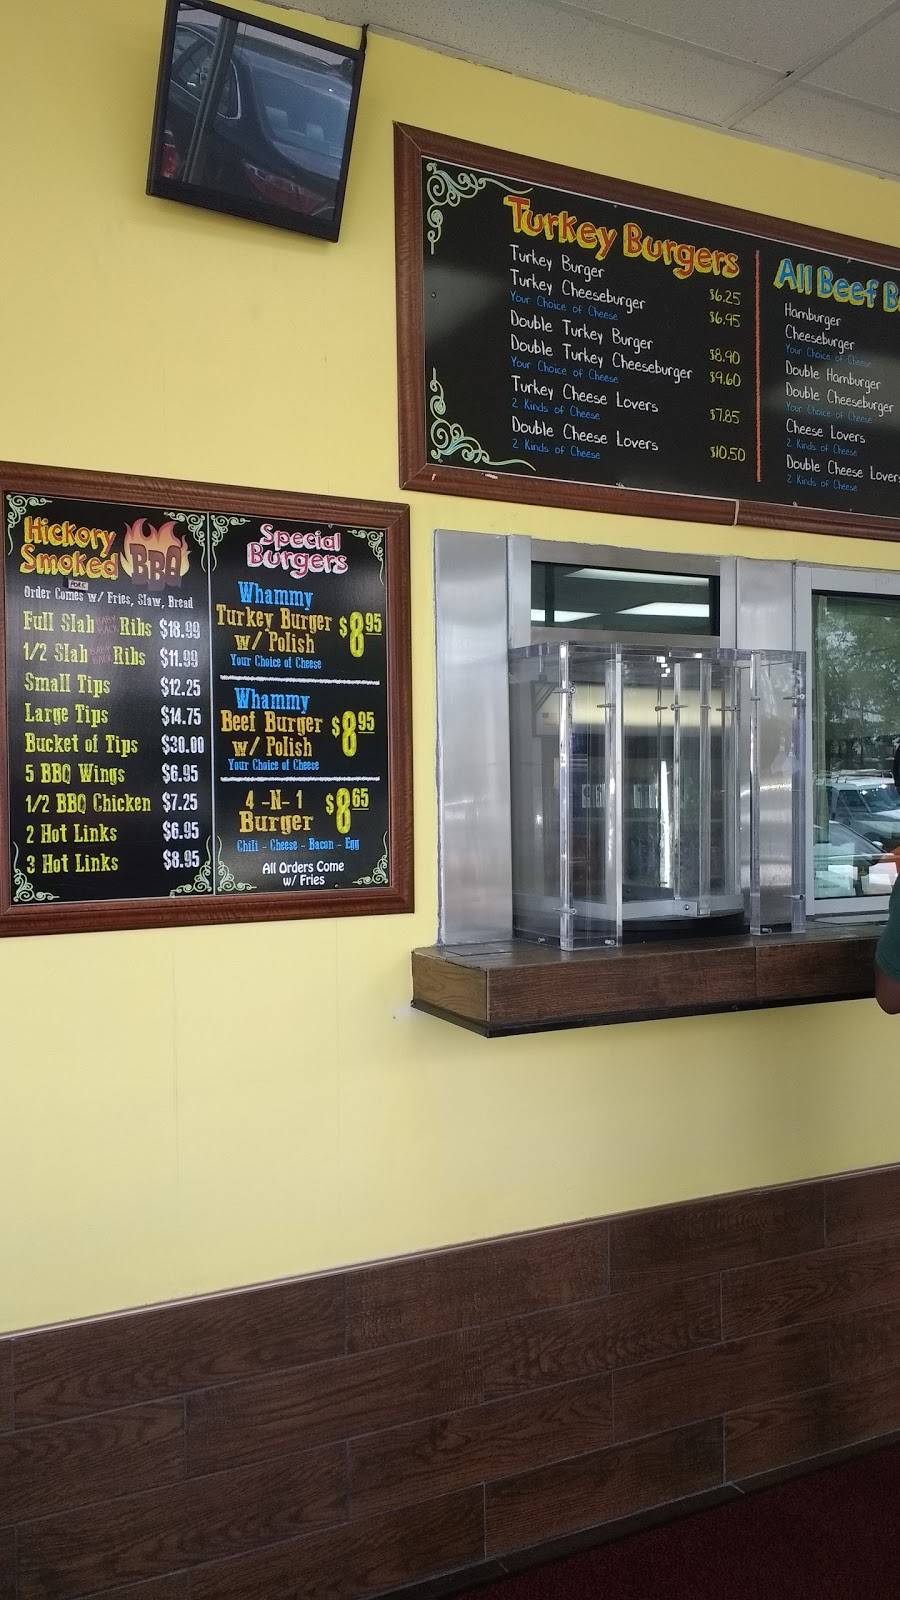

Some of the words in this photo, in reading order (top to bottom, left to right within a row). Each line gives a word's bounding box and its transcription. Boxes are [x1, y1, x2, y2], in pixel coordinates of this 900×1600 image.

[503, 195, 617, 261] Turkey
[623, 222, 740, 280] Burgers
[510, 244, 552, 270] Turkey
[561, 254, 605, 283] Burger
[510, 269, 553, 295] Turkey
[561, 280, 646, 314] Cheeseburger
[709, 289, 741, 305] $6.25
[773, 258, 813, 295] All
[817, 265, 879, 308] Beef
[883, 281, 900, 313] B
[510, 291, 530, 305] Your
[536, 296, 566, 311] Choice
[572, 305, 583, 314] of
[588, 307, 618, 321] Cheese
[785, 303, 841, 331] Hamburger
[709, 311, 741, 327] $6.95
[510, 310, 553, 333] Double
[562, 319, 603, 345] Turkey
[612, 328, 654, 354] Burger
[785, 324, 855, 355] Cheeseburger
[511, 334, 553, 357] Double
[562, 343, 604, 368] Turkey
[612, 352, 693, 384] Cheeseburger
[709, 348, 741, 365] $8.90
[785, 344, 801, 355] Your
[807, 347, 830, 361] Choice
[835, 354, 845, 363] of
[848, 355, 872, 368] Cheese
[511, 356, 530, 369] Your
[538, 361, 567, 376] Choice
[573, 368, 583, 377] of
[589, 370, 619, 384] Cheese
[709, 371, 741, 387] $9.60
[785, 360, 820, 379] Double
[826, 368, 881, 394] Hamburger
[511, 375, 553, 400] Turkey
[563, 383, 607, 405] Cheese
[616, 392, 659, 413] Lovers
[785, 382, 820, 401] Double
[827, 389, 894, 417] Cheeseburger
[512, 399, 518, 408] 2
[524, 401, 548, 413] Kinds
[555, 406, 565, 415] of
[570, 406, 601, 420] Cheese
[709, 408, 741, 424] $7.85
[785, 403, 802, 414] Your
[807, 405, 832, 417] Choice
[836, 411, 846, 419] of
[848, 411, 873, 424] Cheese
[512, 415, 554, 437] Double
[563, 424, 608, 445] Cheese
[616, 431, 659, 451] Lovers
[786, 418, 823, 437] Cheese
[831, 425, 865, 444] Lovers
[512, 439, 518, 449] 2
[524, 440, 549, 453] Kinds
[555, 446, 565, 455] of
[570, 444, 601, 460] Cheese
[709, 446, 746, 462] $10.50
[787, 439, 792, 448] 2
[796, 439, 816, 451] Kinds
[820, 444, 830, 452] of
[833, 444, 858, 457] Cheese
[787, 455, 821, 473] Double
[828, 460, 863, 479] Cheese
[787, 475, 792, 483] 2
[796, 474, 817, 486] Kinds
[821, 480, 830, 488] of
[833, 479, 858, 492] Cheese
[23, 516, 117, 557] Hickory
[259, 523, 342, 551] Special
[19, 544, 120, 580] Smoked
[129, 543, 182, 587] BBQ
[246, 542, 348, 579] Burgers
[24, 586, 51, 599] Order
[55, 588, 84, 602] Comes
[88, 593, 104, 603] w/
[107, 591, 134, 606] Fries,
[138, 594, 165, 609] Slaw,
[168, 595, 194, 609] Bread
[238, 581, 314, 610] Whammy
[23, 610, 54, 631] Full
[119, 617, 152, 637] Ribs
[160, 619, 201, 639] $18.99
[216, 604, 274, 632] Turkey
[280, 608, 333, 633] Burger
[234, 631, 262, 651] w/
[268, 631, 315, 654] Polish
[23, 643, 47, 662] 1/2
[113, 646, 146, 666] Ribs
[160, 647, 198, 668] $11.99
[230, 654, 251, 666] Your
[255, 655, 280, 668] Choice
[284, 658, 292, 668] of
[296, 657, 322, 669] Cheese
[24, 673, 70, 695] Small
[77, 674, 111, 698] Tips
[160, 676, 201, 698] $12.25
[234, 688, 310, 713] Whammy
[24, 703, 69, 725] Large
[74, 704, 109, 728] Tips
[161, 705, 201, 726] $14.75
[220, 710, 256, 732] Beef
[264, 711, 323, 736] Burger
[25, 733, 78, 754] Bucket
[85, 734, 98, 753] of
[106, 735, 138, 758] Tips
[161, 734, 204, 755] $30.00
[232, 736, 260, 757] w/
[266, 736, 313, 757] Polish
[26, 764, 34, 783] 5
[41, 763, 70, 785] BBQ
[78, 764, 125, 785] Wings
[161, 763, 198, 784] $6.95
[228, 758, 250, 770] Your
[253, 759, 279, 770] Choice
[282, 759, 290, 770] of
[293, 759, 319, 771] Cheese
[26, 794, 50, 813] 1/2
[56, 793, 87, 814] BBQ
[93, 792, 151, 812] Chicken
[162, 792, 198, 813] $7.25
[245, 790, 254, 809] 4
[296, 790, 303, 808] 1
[26, 825, 35, 843] 2
[41, 824, 67, 843] Hot
[74, 824, 118, 843] Links
[162, 821, 199, 842] $6.95
[239, 811, 314, 835] Burger
[236, 839, 258, 852] Chili
[270, 838, 297, 851] Cheese
[309, 838, 334, 850] Bacon
[345, 837, 360, 850] Egg
[26, 855, 35, 874] 3
[42, 854, 69, 873] Hot
[75, 854, 119, 873] Links
[163, 849, 200, 871] $8.95
[262, 862, 276, 874] All
[279, 862, 314, 873] Orders
[317, 861, 344, 872] Come
[283, 876, 296, 887] w/
[300, 874, 325, 886] Fries
